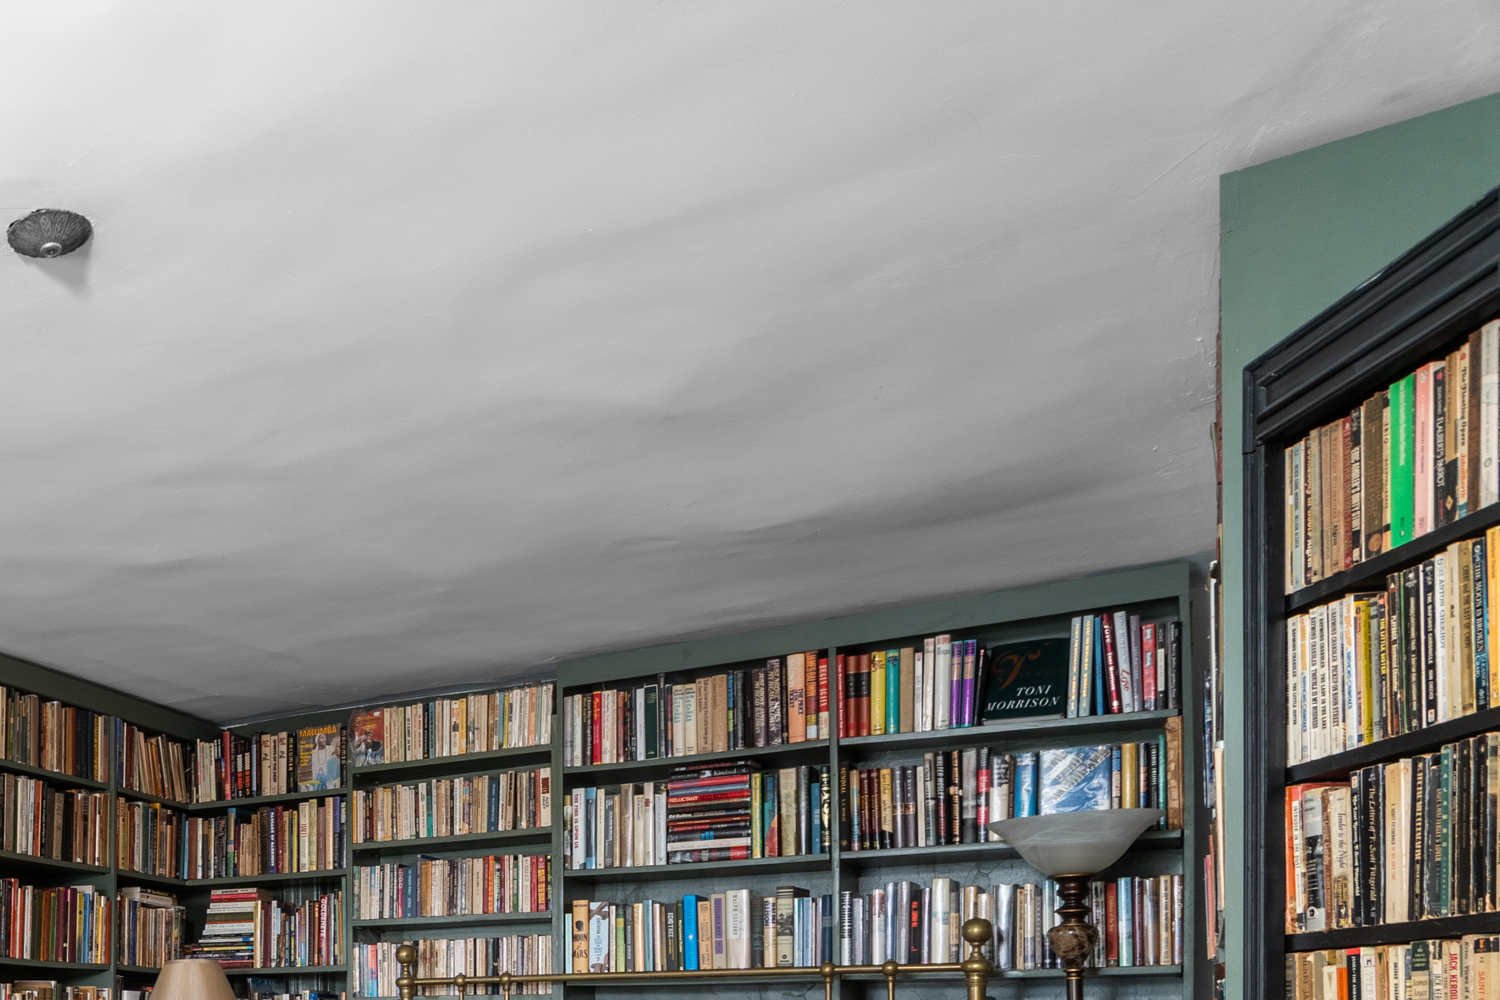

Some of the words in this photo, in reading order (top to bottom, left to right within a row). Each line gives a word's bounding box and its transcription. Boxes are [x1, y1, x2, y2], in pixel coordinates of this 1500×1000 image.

[1436, 416, 1444, 458] FLAUBERT'S
[1436, 459, 1444, 487] PARROT
[1474, 563, 1485, 580] THE
[1474, 581, 1485, 608] MOON
[1474, 609, 1485, 617] IS
[1474, 618, 1485, 652] BROKEN
[806, 654, 816, 670] JAMES
[806, 670, 816, 697] BALDWIN
[820, 664, 828, 686] BEGIN
[1121, 669, 1130, 691] Love
[820, 688, 828, 707] AGAIN
[1016, 684, 1052, 696] TONI
[984, 696, 1060, 712] MORRISON
[300, 726, 337, 738] MACUMBA
[541, 778, 550, 794] ROOTS
[573, 934, 587, 942] MOON
[573, 950, 588, 958] MARS
[1450, 952, 1458, 970] JACK
[1365, 970, 1374, 996] MINOR
